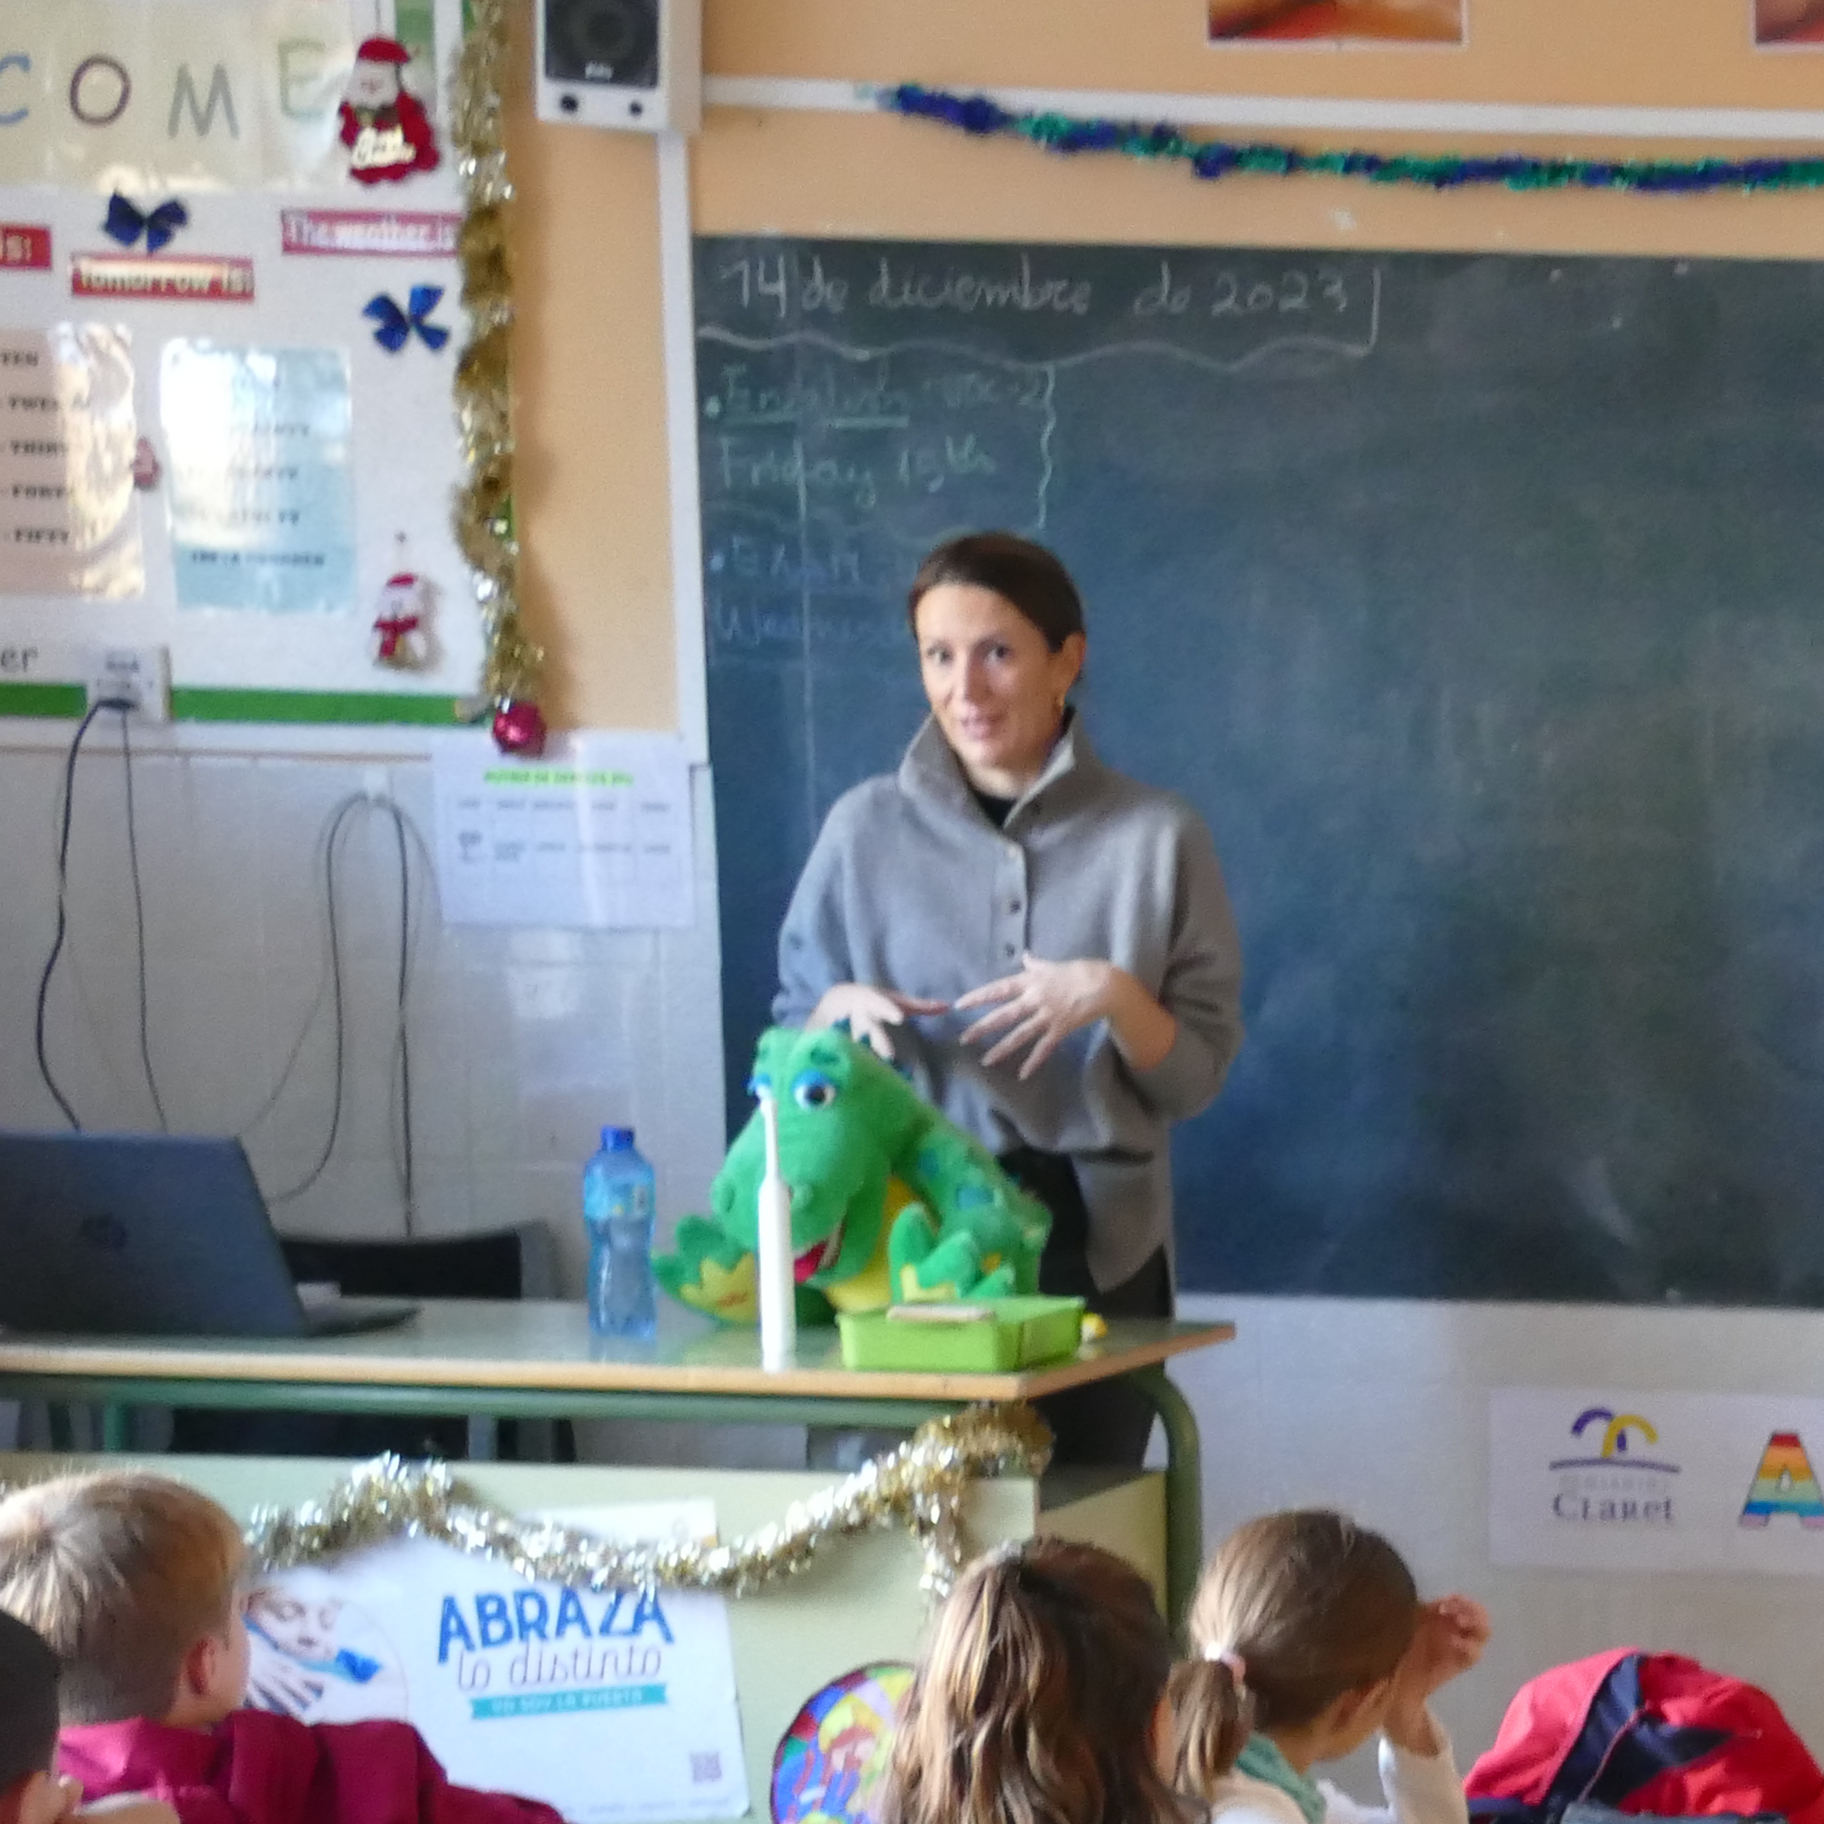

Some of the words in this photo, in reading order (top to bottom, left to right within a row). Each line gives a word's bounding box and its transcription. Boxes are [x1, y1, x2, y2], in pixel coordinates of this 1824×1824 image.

[720, 255, 786, 319] 14
[1134, 258, 1191, 315] de
[437, 1584, 676, 1666] ABRAZA
[458, 1647, 491, 1692] lo
[509, 1641, 662, 1687] distinto
